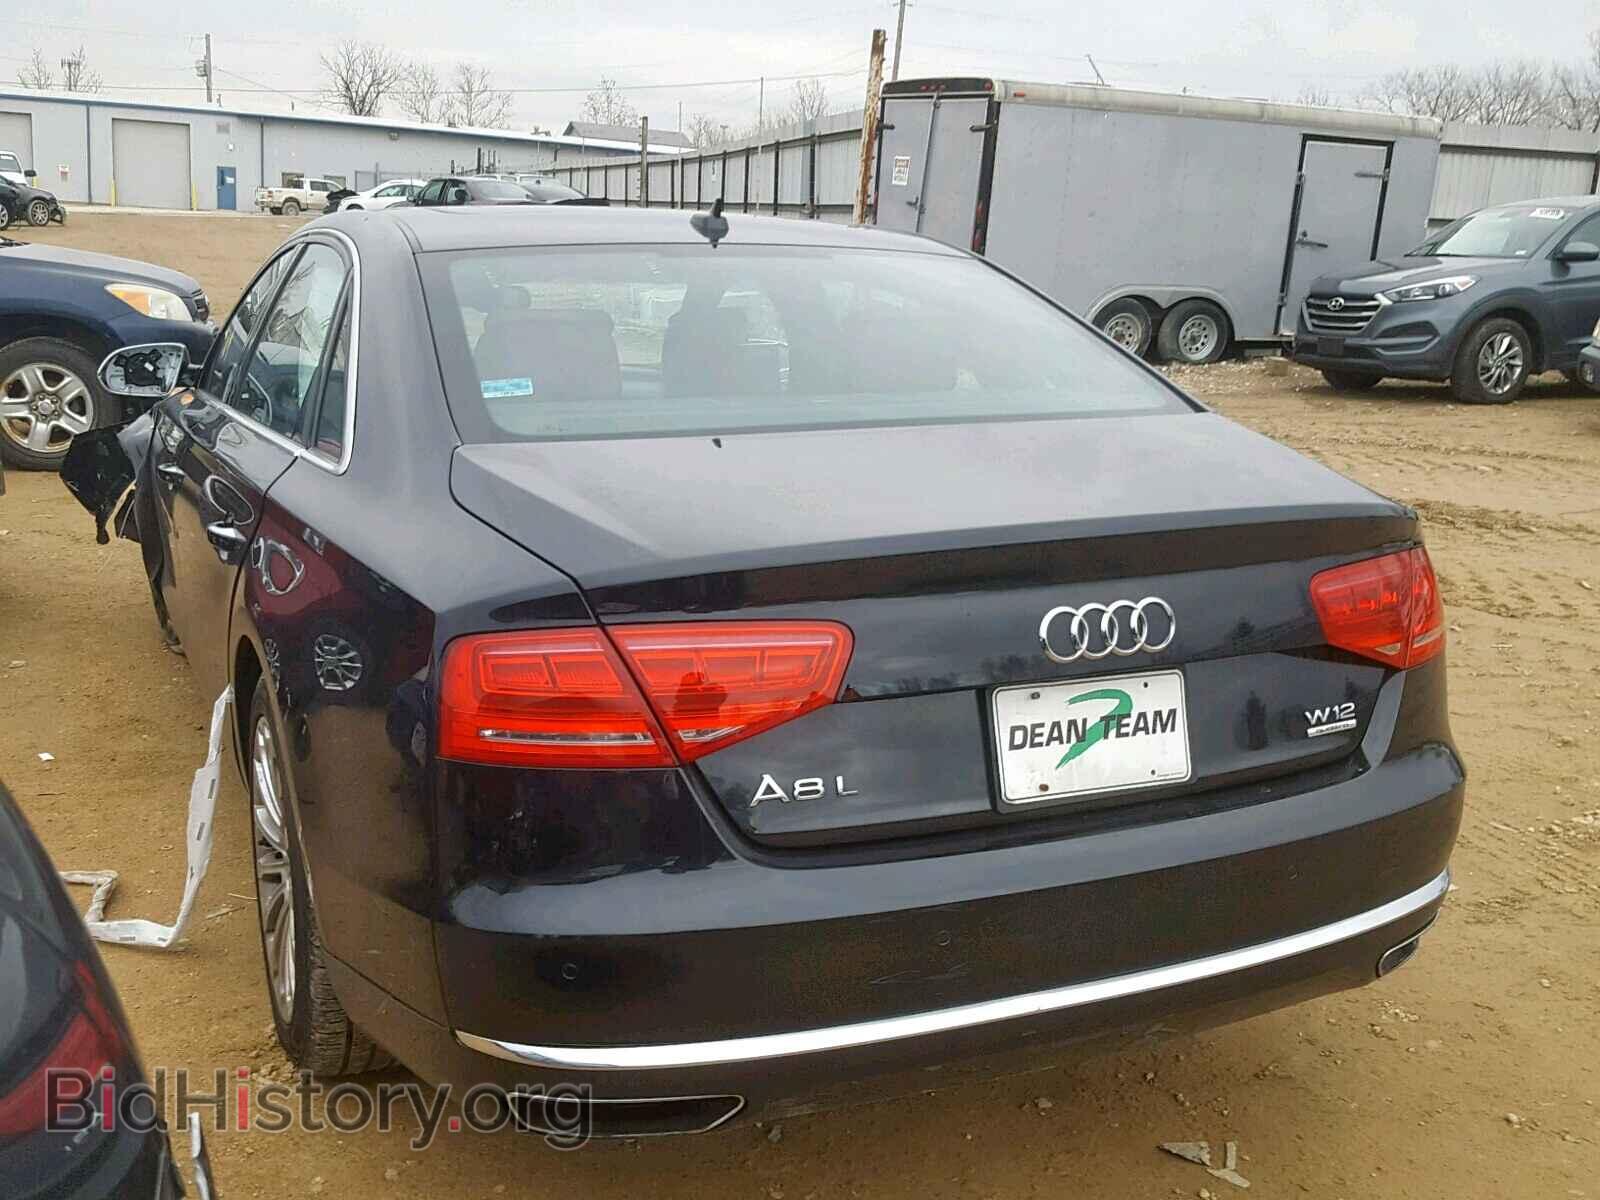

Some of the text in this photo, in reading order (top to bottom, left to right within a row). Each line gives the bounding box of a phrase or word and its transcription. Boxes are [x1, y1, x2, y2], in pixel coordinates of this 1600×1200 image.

[1008, 708, 1177, 752] DEAN TEAM
[1304, 702, 1356, 726] W12
[750, 773, 859, 808] A8 L
